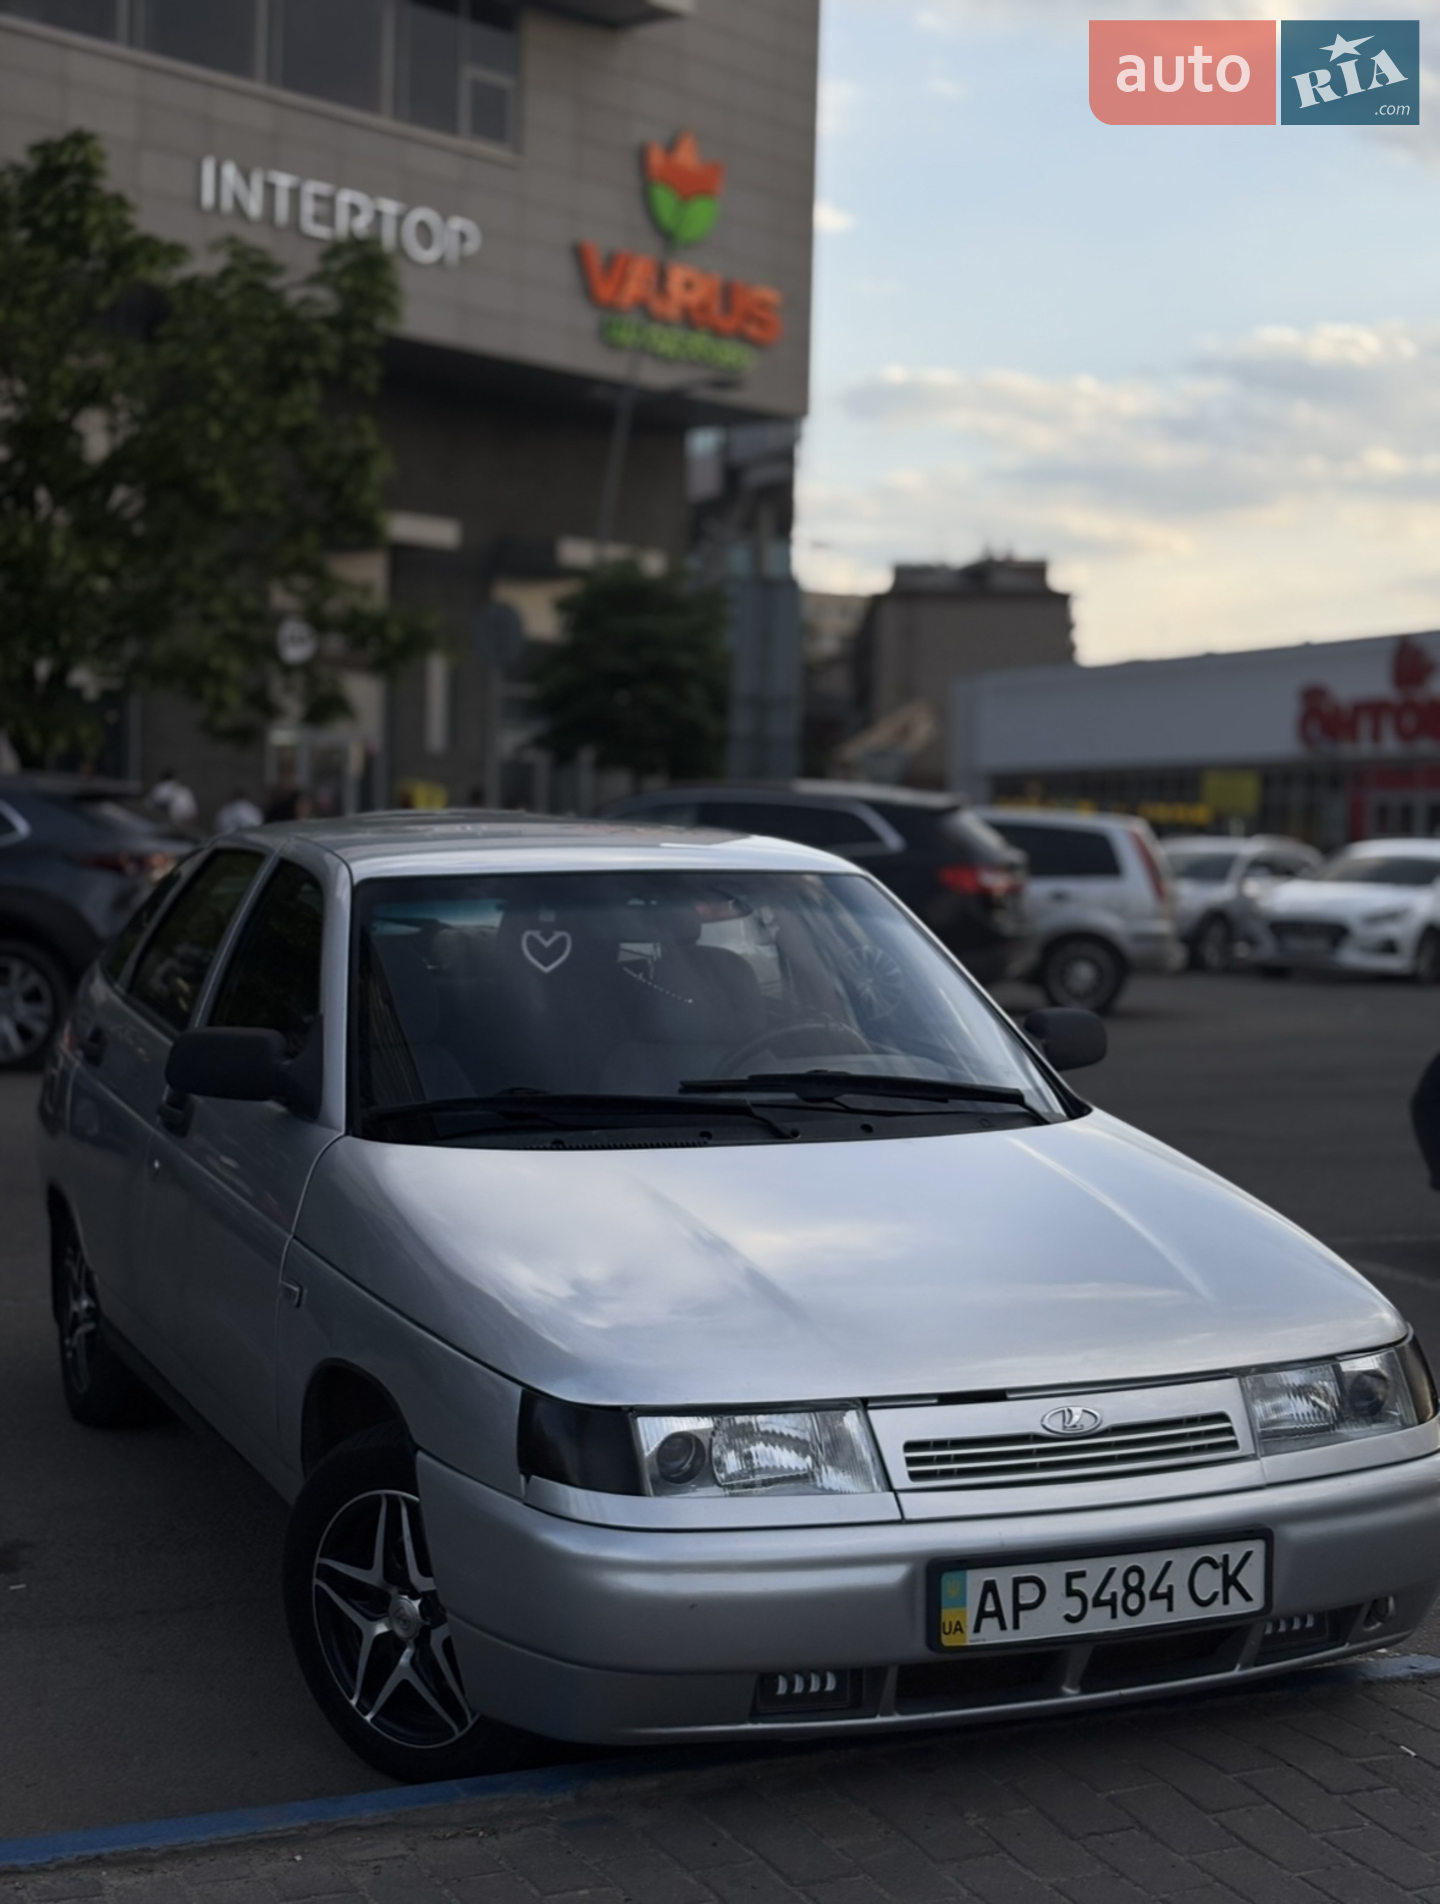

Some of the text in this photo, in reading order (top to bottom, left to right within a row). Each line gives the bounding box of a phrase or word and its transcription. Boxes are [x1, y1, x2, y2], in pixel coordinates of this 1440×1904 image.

[199, 154, 483, 269] INTERTOP
[578, 240, 783, 346] VARUS
[941, 1620, 965, 1636] UA
[972, 1549, 1255, 1634] AP 5484 CK
